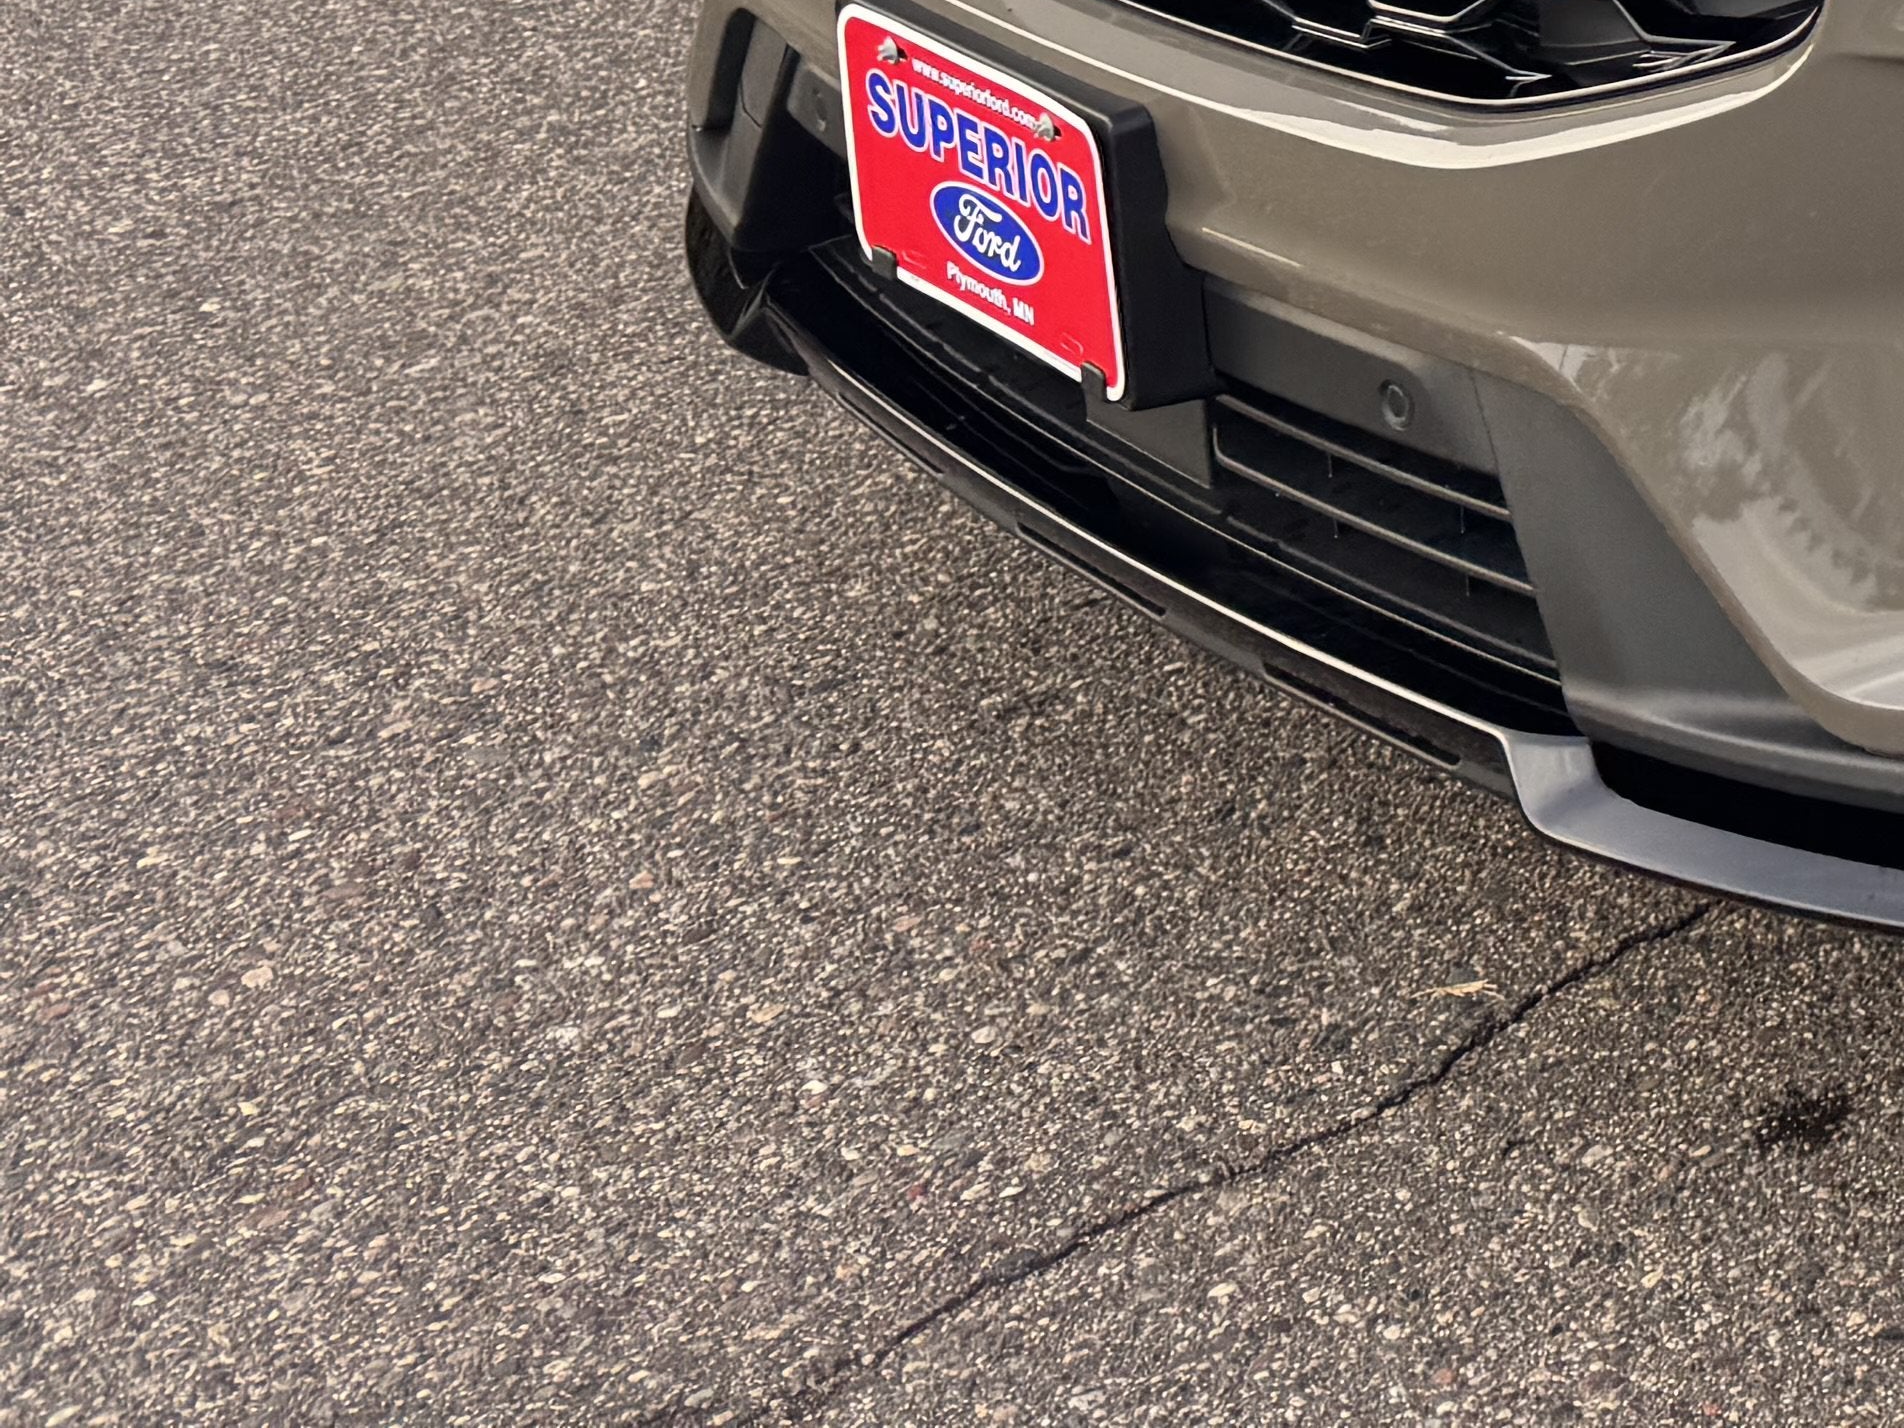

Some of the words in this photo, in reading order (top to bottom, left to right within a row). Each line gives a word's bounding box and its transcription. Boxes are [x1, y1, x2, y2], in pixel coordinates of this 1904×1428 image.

[866, 69, 1092, 245] SUPERIOR
[953, 192, 1022, 272] Ford
[946, 260, 1011, 316] Plymouth,
[1013, 297, 1035, 326] MN
